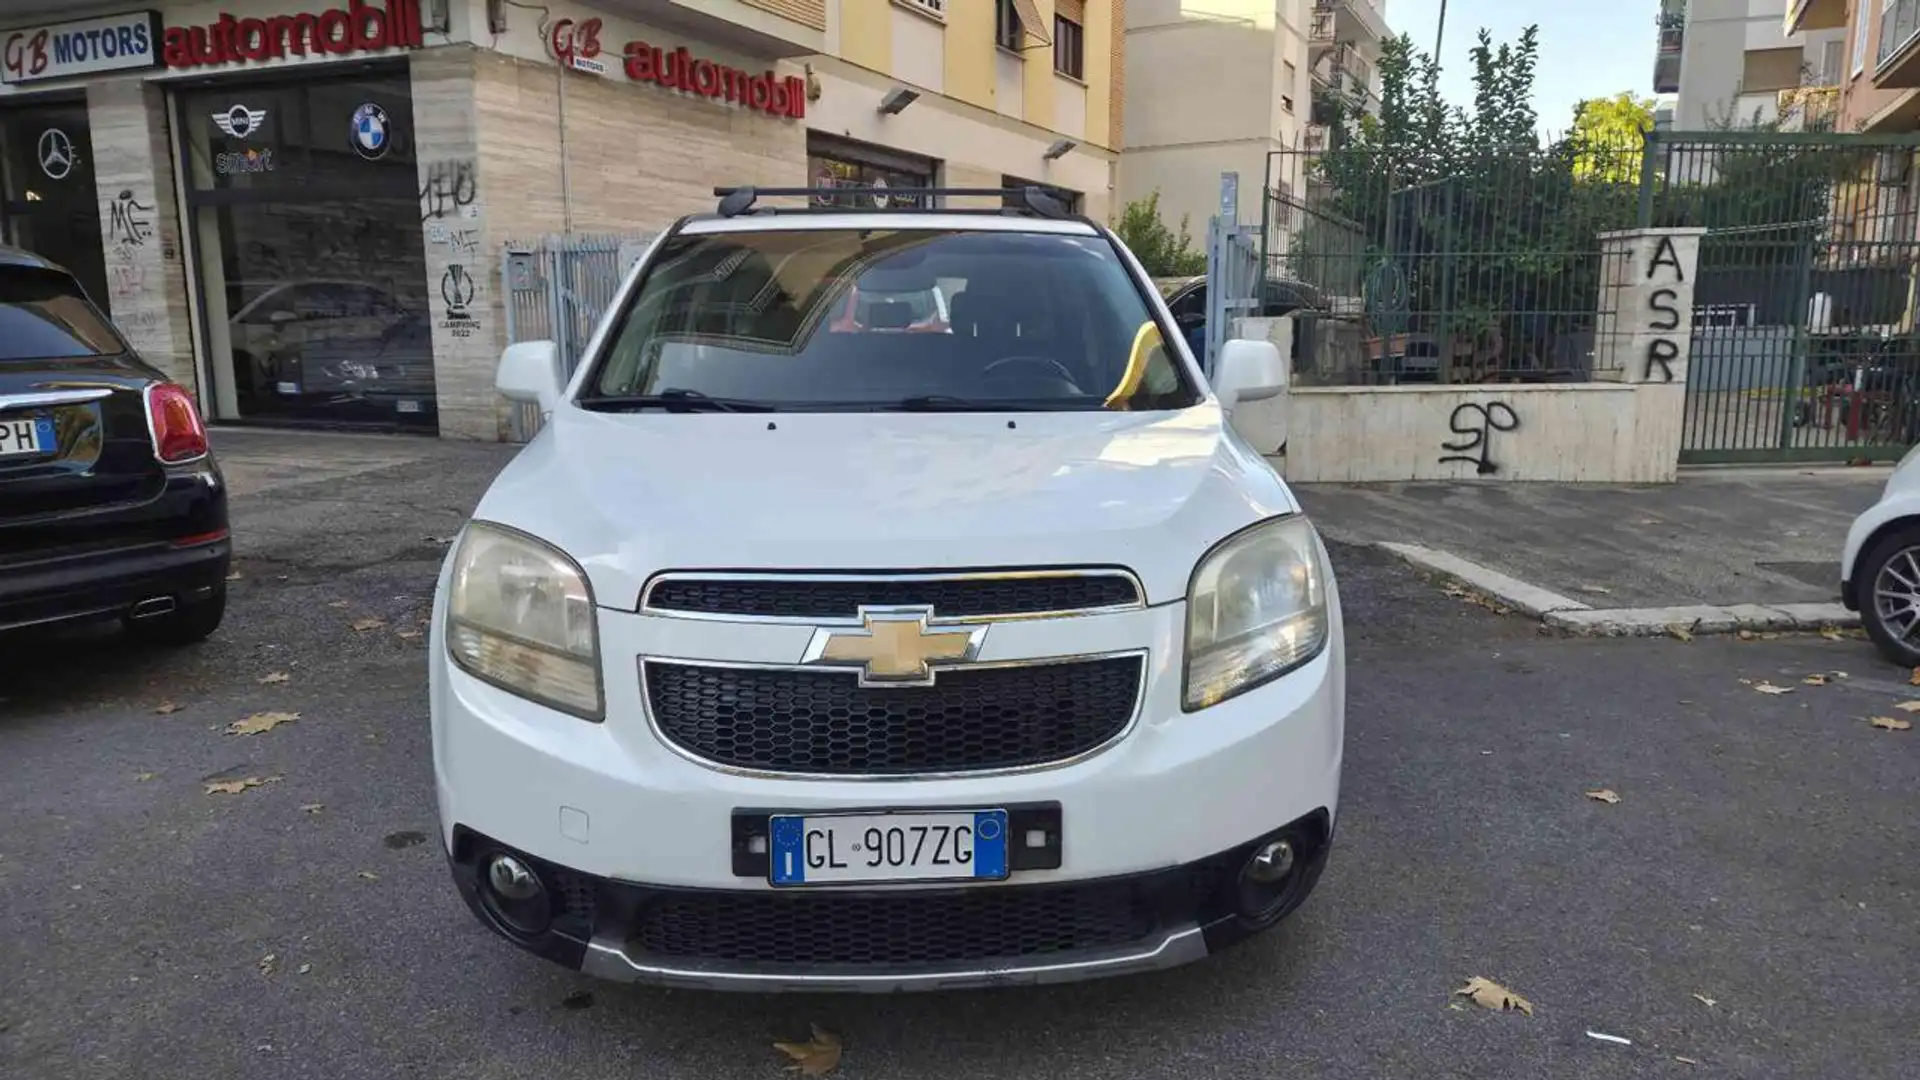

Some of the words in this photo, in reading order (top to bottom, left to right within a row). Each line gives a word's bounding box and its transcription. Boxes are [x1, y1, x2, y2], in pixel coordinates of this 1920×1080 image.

[53, 22, 149, 64] MOTORS
[623, 41, 805, 119] automobili
[806, 829, 847, 869] GL
[864, 826, 972, 867] 907ZG
